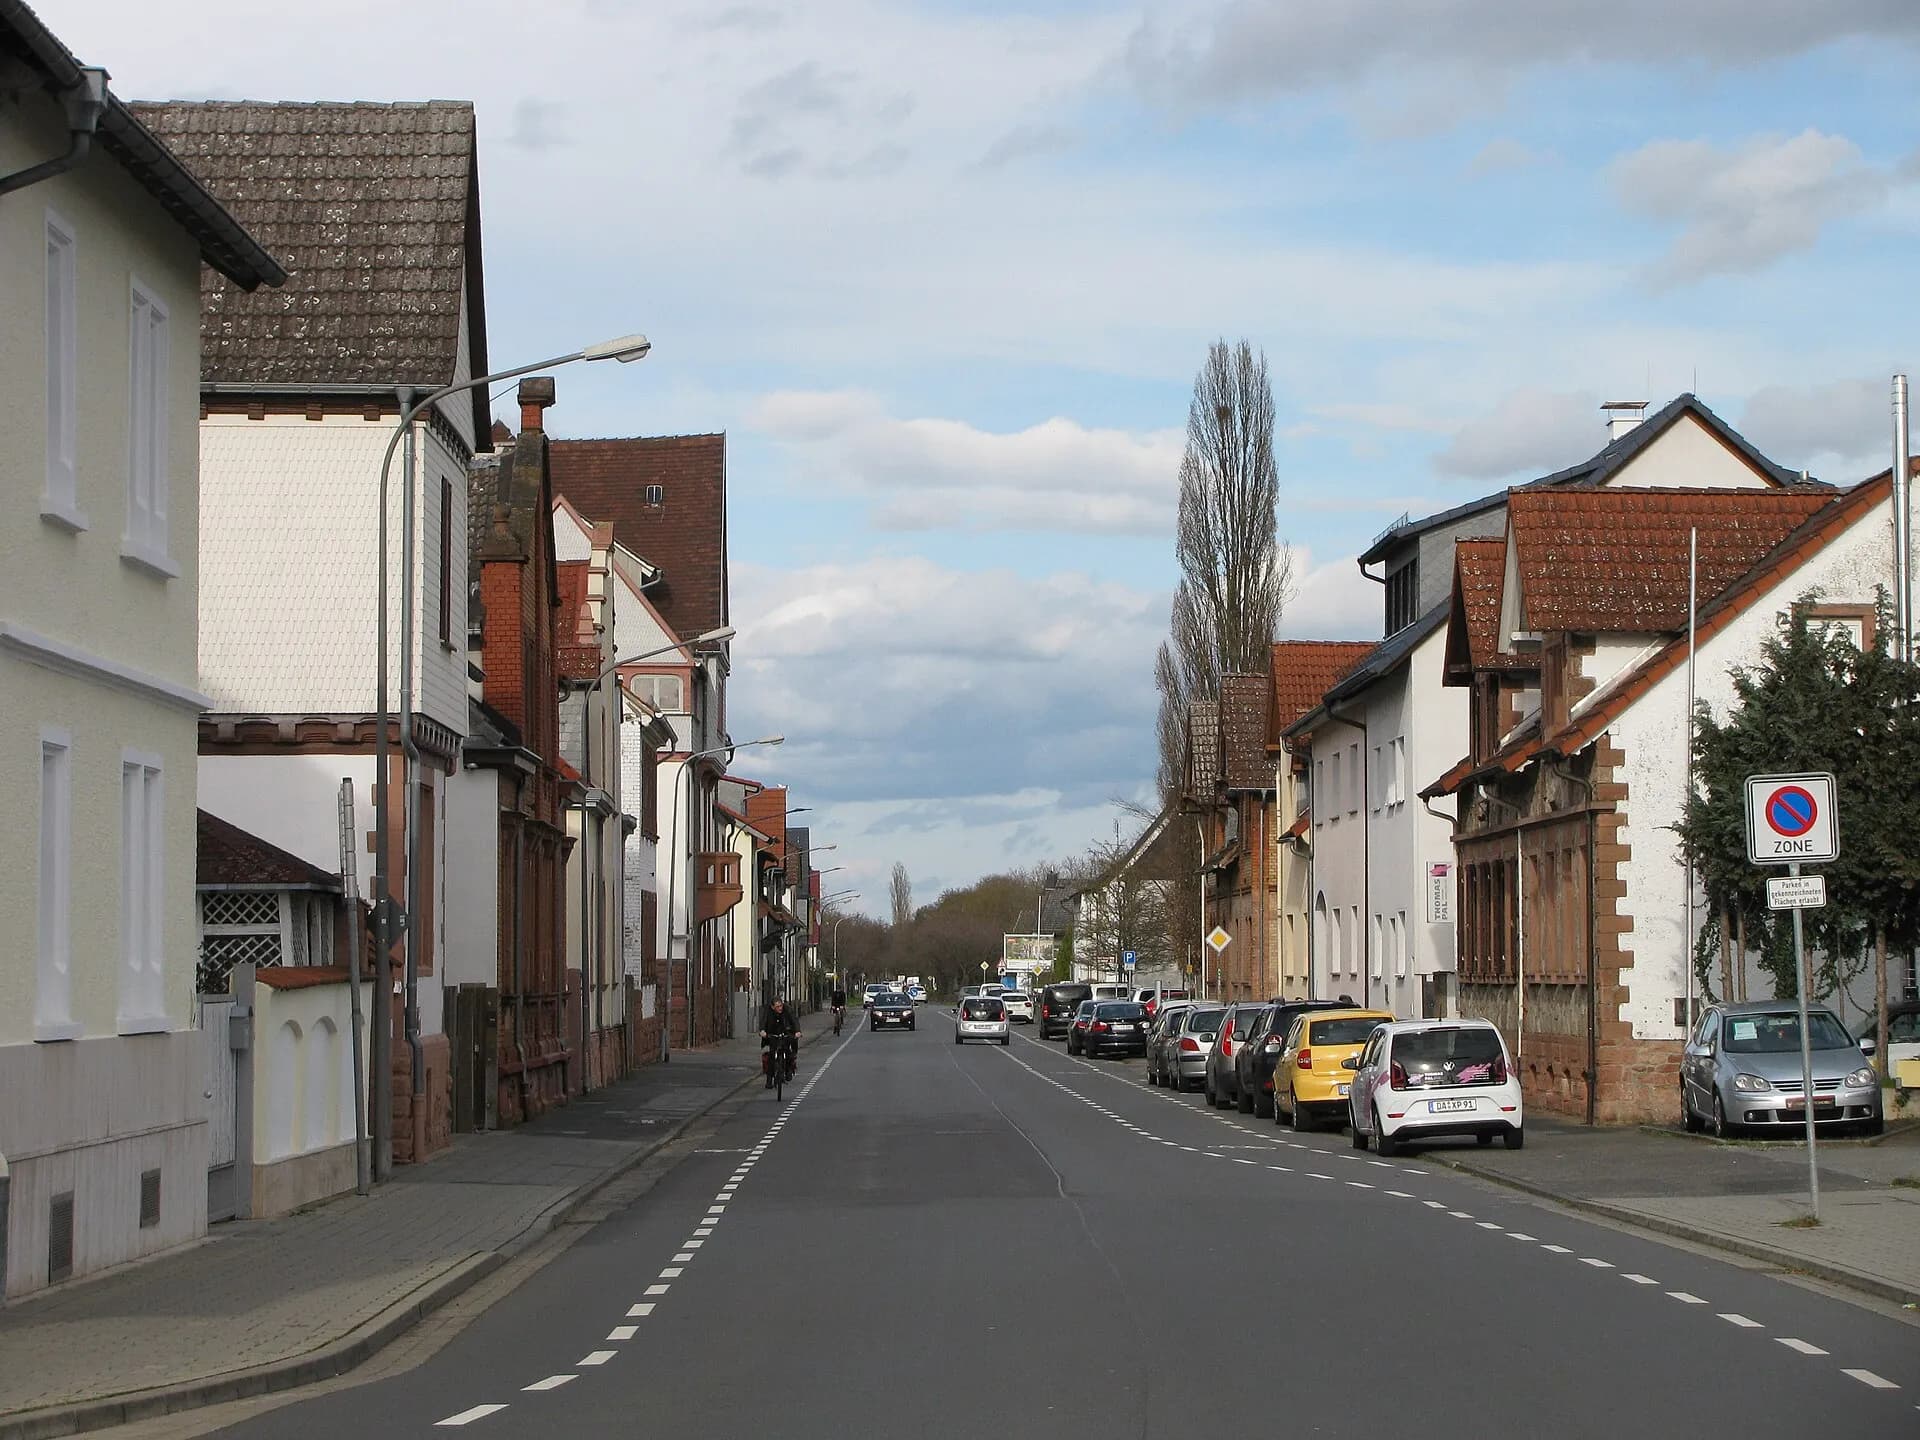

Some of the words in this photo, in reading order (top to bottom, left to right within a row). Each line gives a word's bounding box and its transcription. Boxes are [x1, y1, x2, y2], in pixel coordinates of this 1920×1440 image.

[1774, 840, 1813, 853] ZONE
[1771, 889, 1821, 899] gekennzeichneten
[1774, 898, 1797, 906] Flächen
[1799, 896, 1820, 904] erlaubt
[1126, 952, 1133, 963] P
